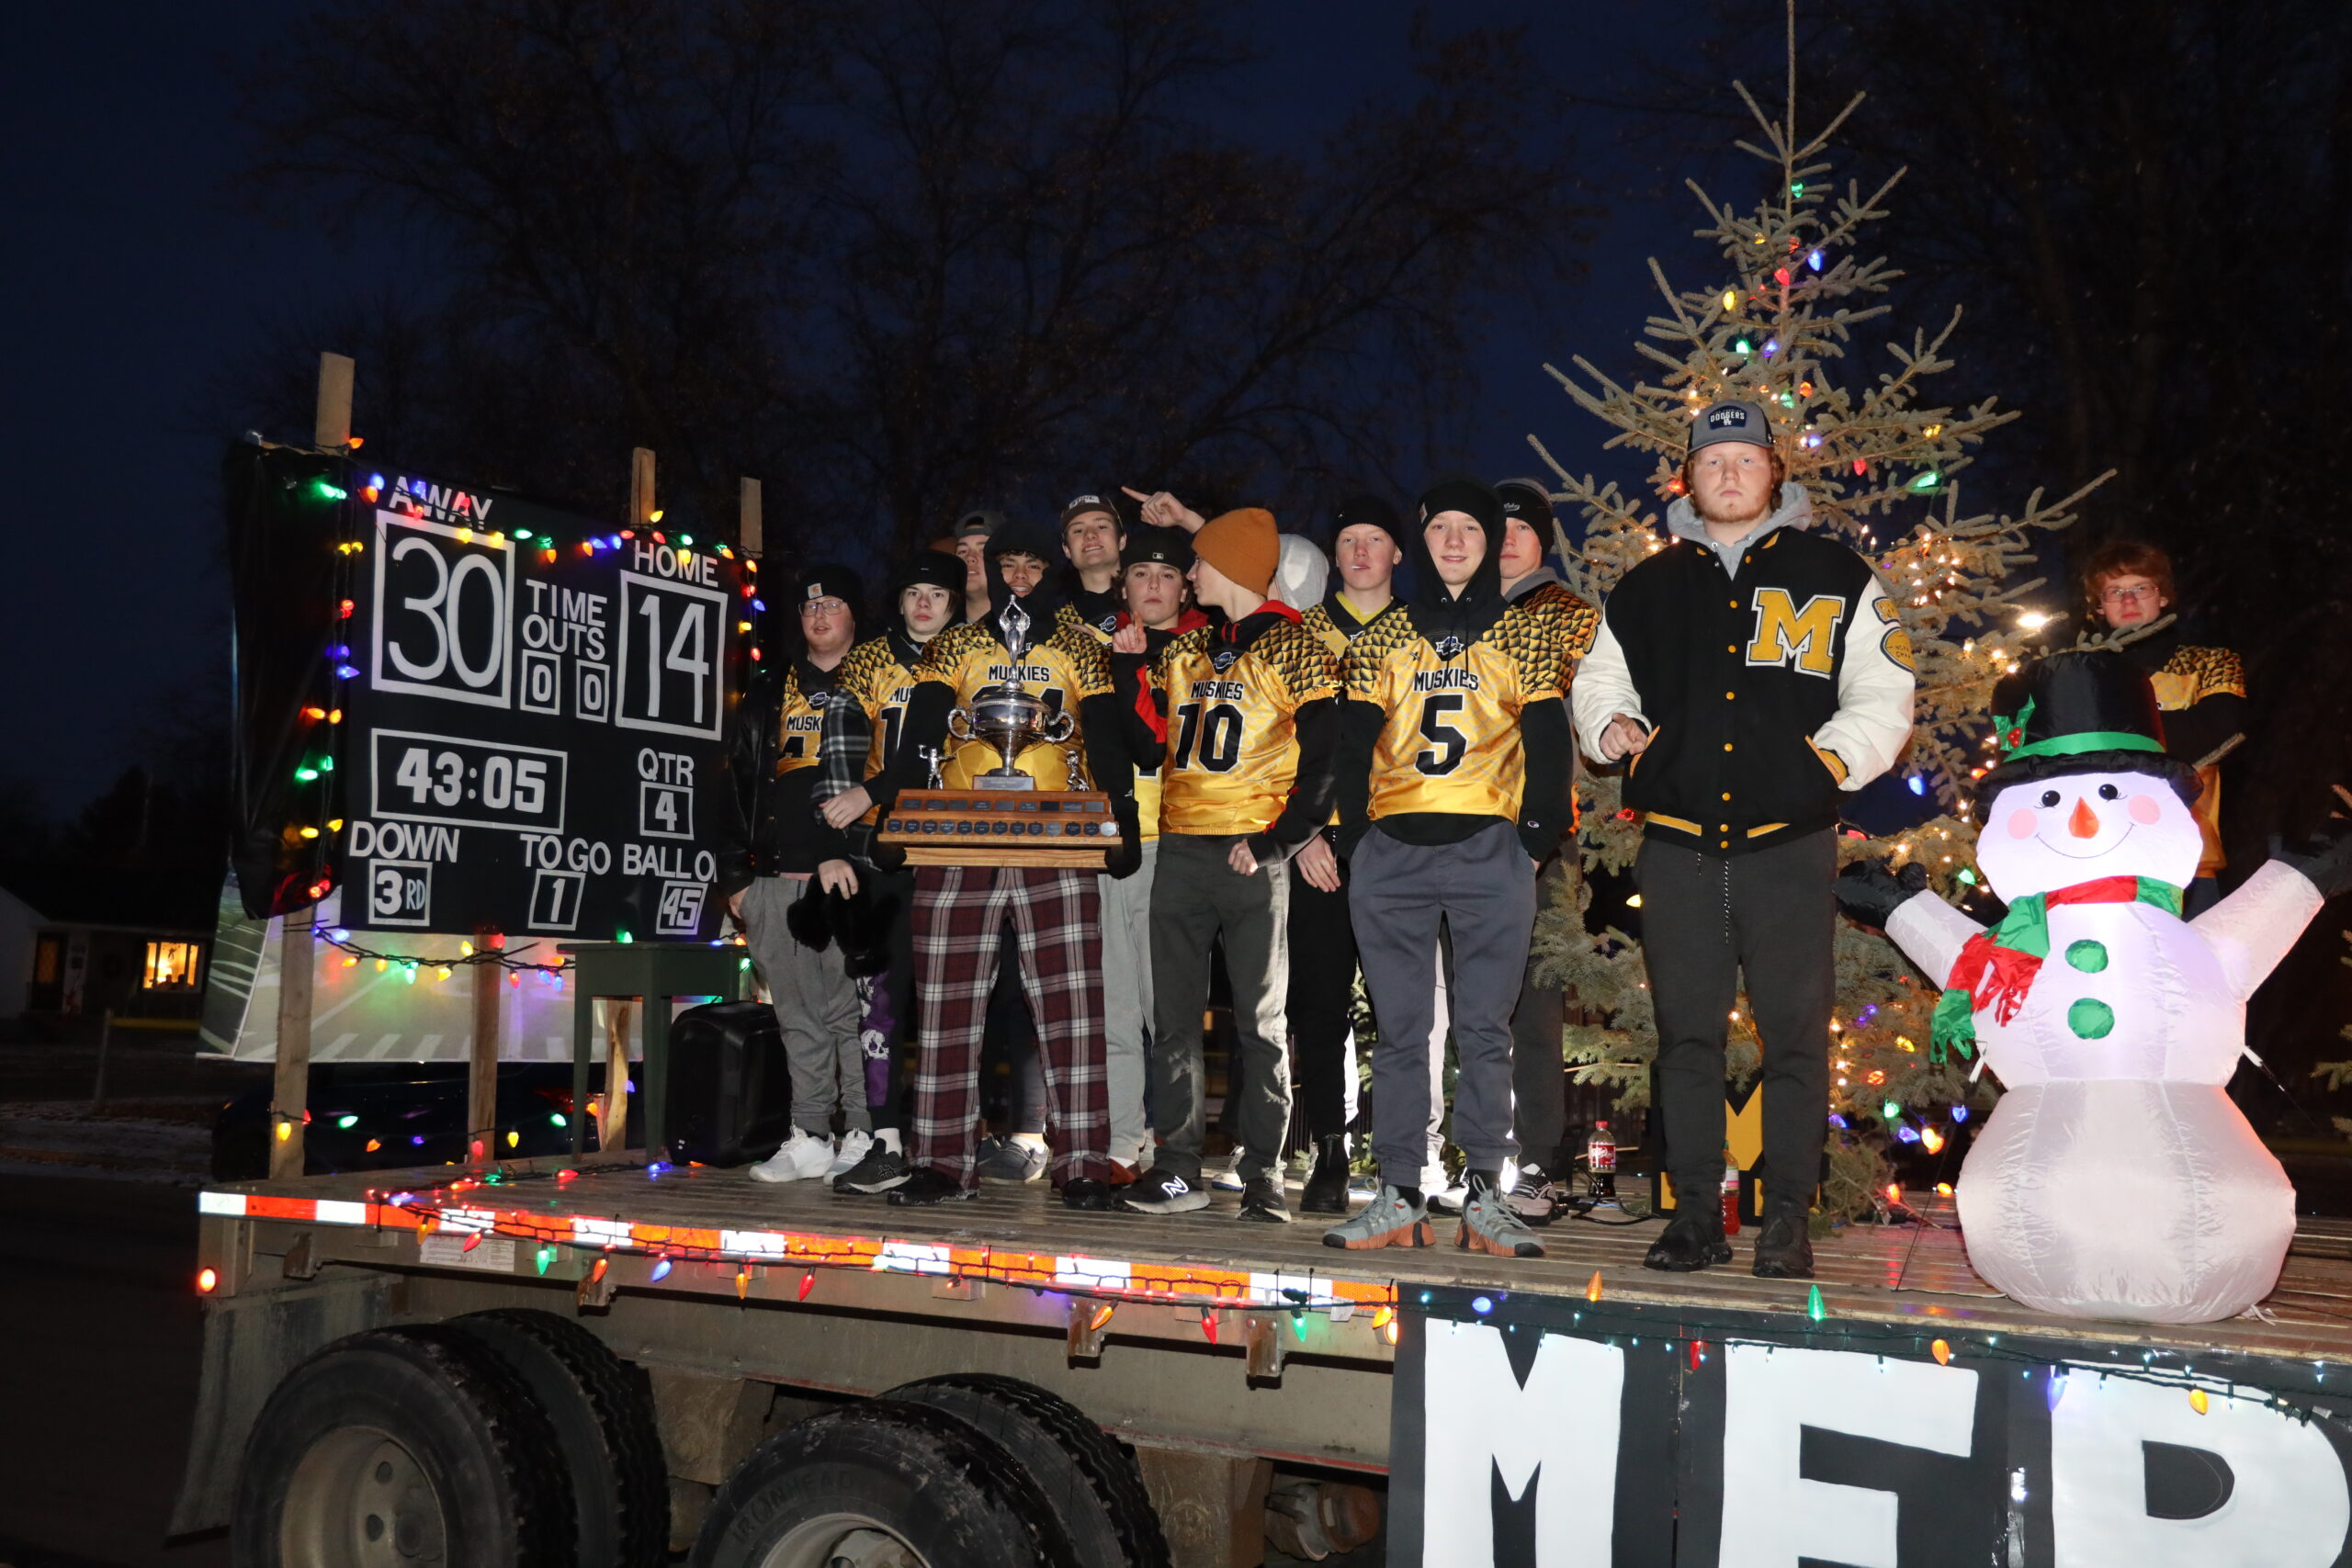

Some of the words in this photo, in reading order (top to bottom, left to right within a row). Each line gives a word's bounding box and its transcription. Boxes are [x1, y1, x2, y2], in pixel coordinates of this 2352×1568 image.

[1710, 411, 1745, 423] DODGERS
[389, 476, 493, 531] AWAY
[635, 540, 719, 588] HOME
[388, 536, 505, 688] 30
[526, 579, 607, 628] TIME
[523, 614, 605, 660] OUTS
[1747, 588, 1845, 679] M
[639, 594, 710, 724] 14
[988, 665, 1049, 682] MUKIES
[1413, 668, 1479, 692] MUSKIES
[1191, 681, 1244, 701] MUSKIES
[1173, 702, 1244, 773] 10
[1415, 693, 1467, 776] 5
[397, 748, 547, 814] 43:05
[638, 748, 694, 786] QTR
[655, 792, 678, 831] 4
[349, 821, 459, 863] DOWN
[520, 833, 563, 870] TO
[568, 837, 611, 874] GO
[623, 843, 692, 879] BALL
[695, 851, 718, 883] O
[375, 870, 426, 915] 3RD
[549, 878, 567, 923] 1
[662, 887, 702, 927] 45
